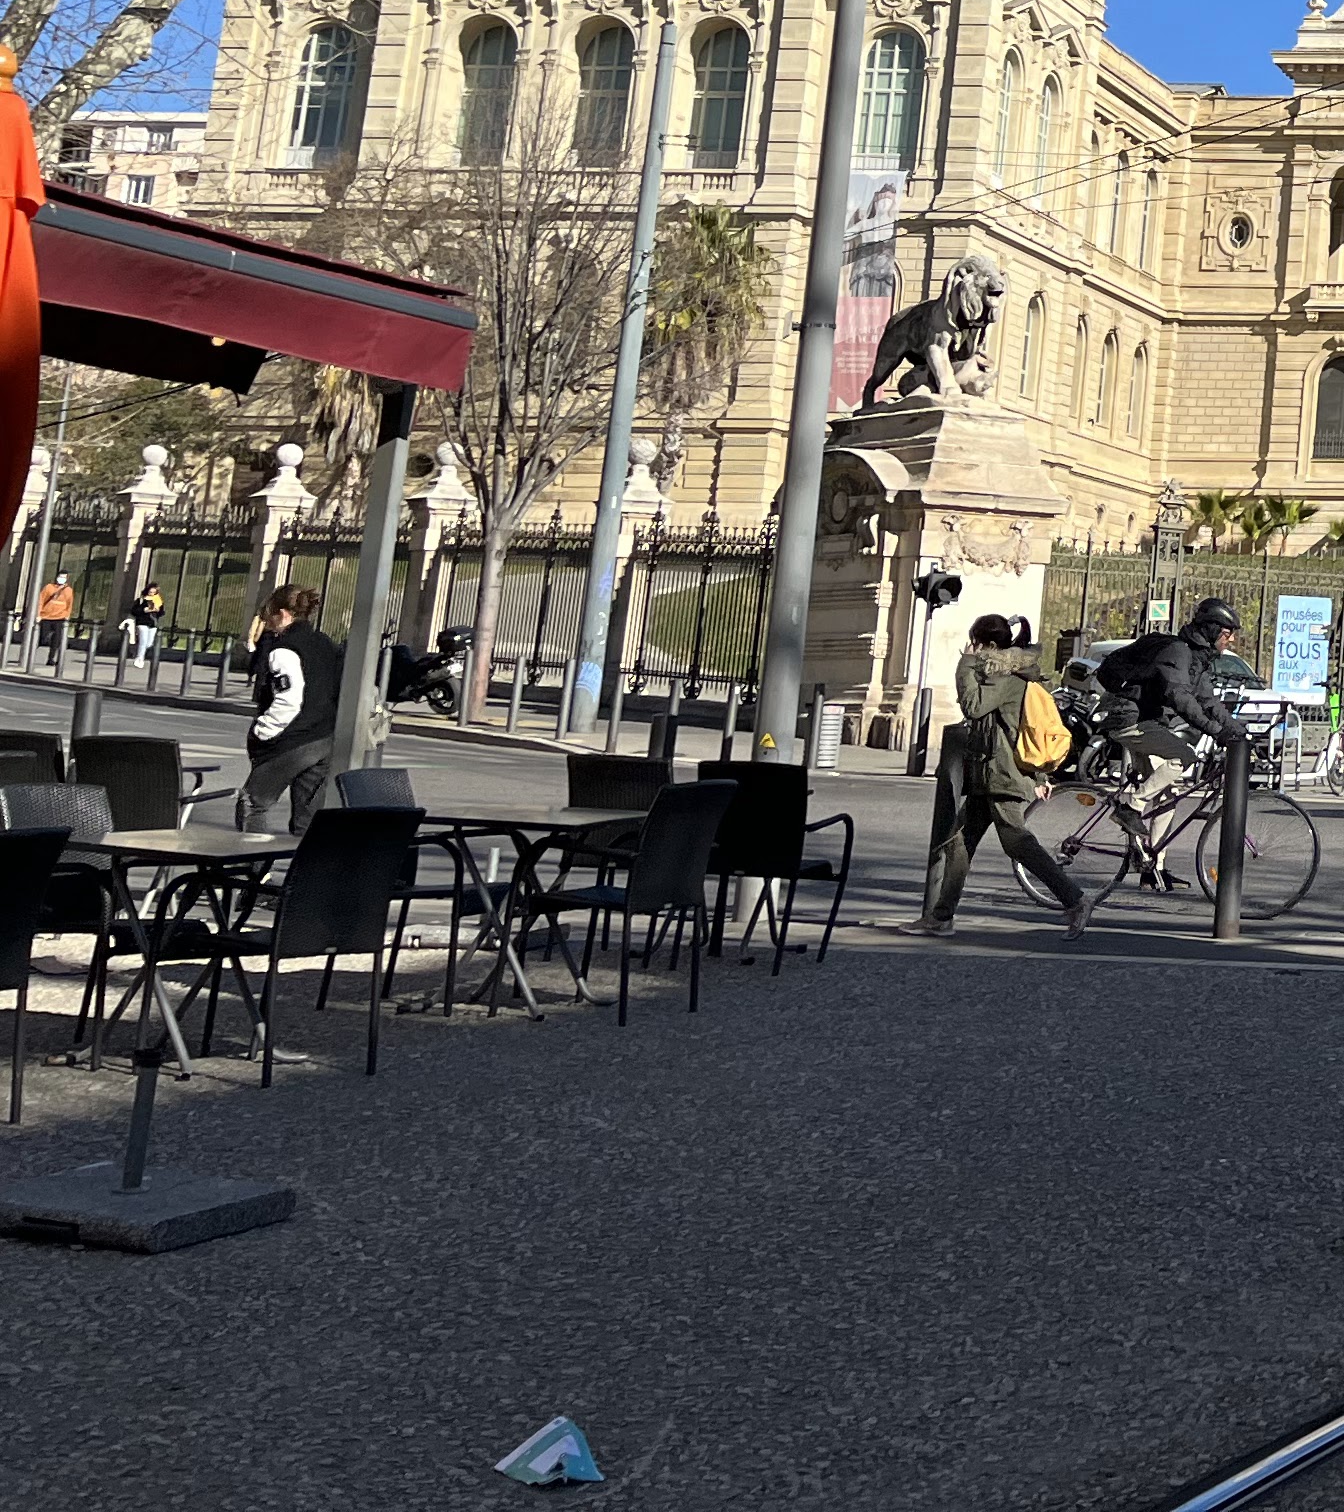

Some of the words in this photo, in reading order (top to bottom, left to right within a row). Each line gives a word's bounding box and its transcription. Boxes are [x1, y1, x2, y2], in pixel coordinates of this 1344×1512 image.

[1281, 608, 1323, 621] musées
[1281, 622, 1307, 634] pour
[1277, 637, 1321, 660] tous
[1278, 659, 1299, 670] aux
